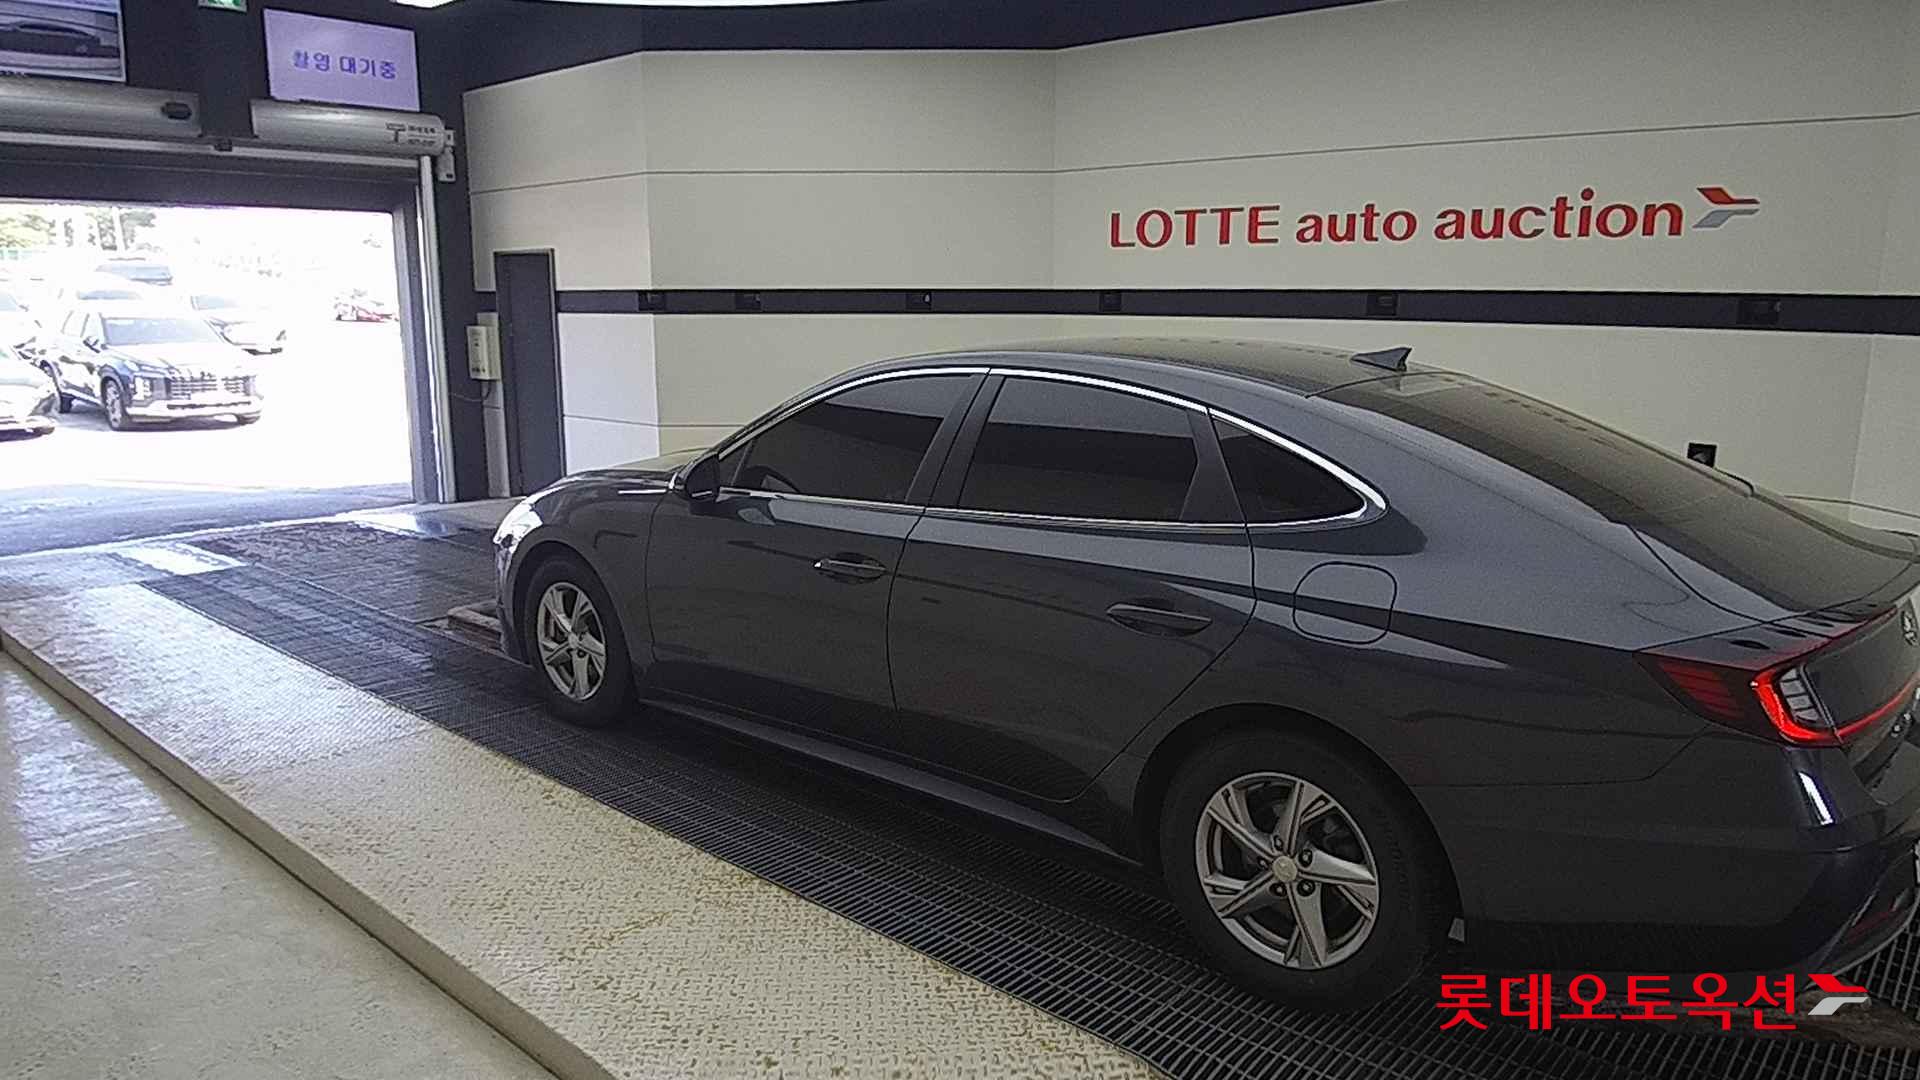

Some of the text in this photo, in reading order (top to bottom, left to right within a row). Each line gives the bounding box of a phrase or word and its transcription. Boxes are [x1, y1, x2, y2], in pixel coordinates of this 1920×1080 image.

[340, 55, 396, 79] 대기중
[1111, 188, 1684, 248] LOTTE auto auction
